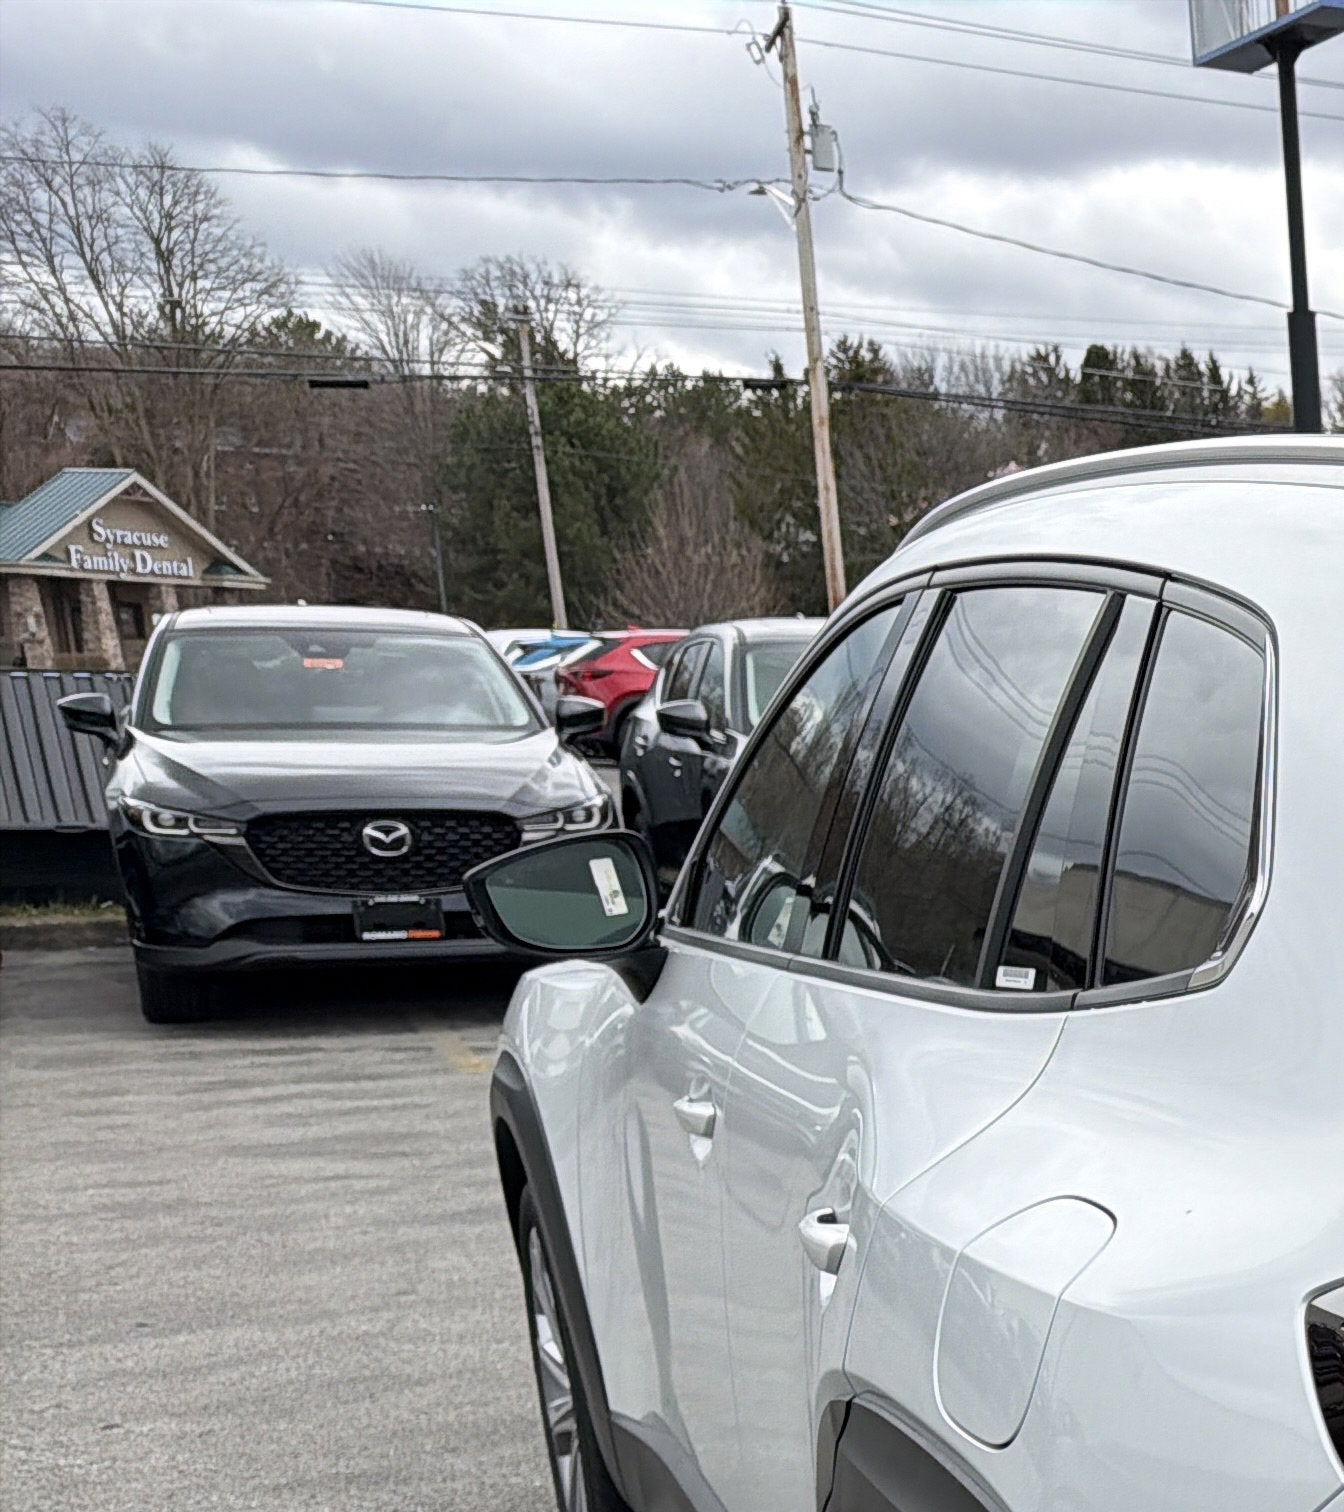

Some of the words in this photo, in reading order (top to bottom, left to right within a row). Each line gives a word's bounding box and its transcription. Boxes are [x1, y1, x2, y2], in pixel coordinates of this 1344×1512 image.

[91, 518, 169, 549] Syracuse
[67, 544, 130, 579] Family
[134, 549, 193, 577] Dental
